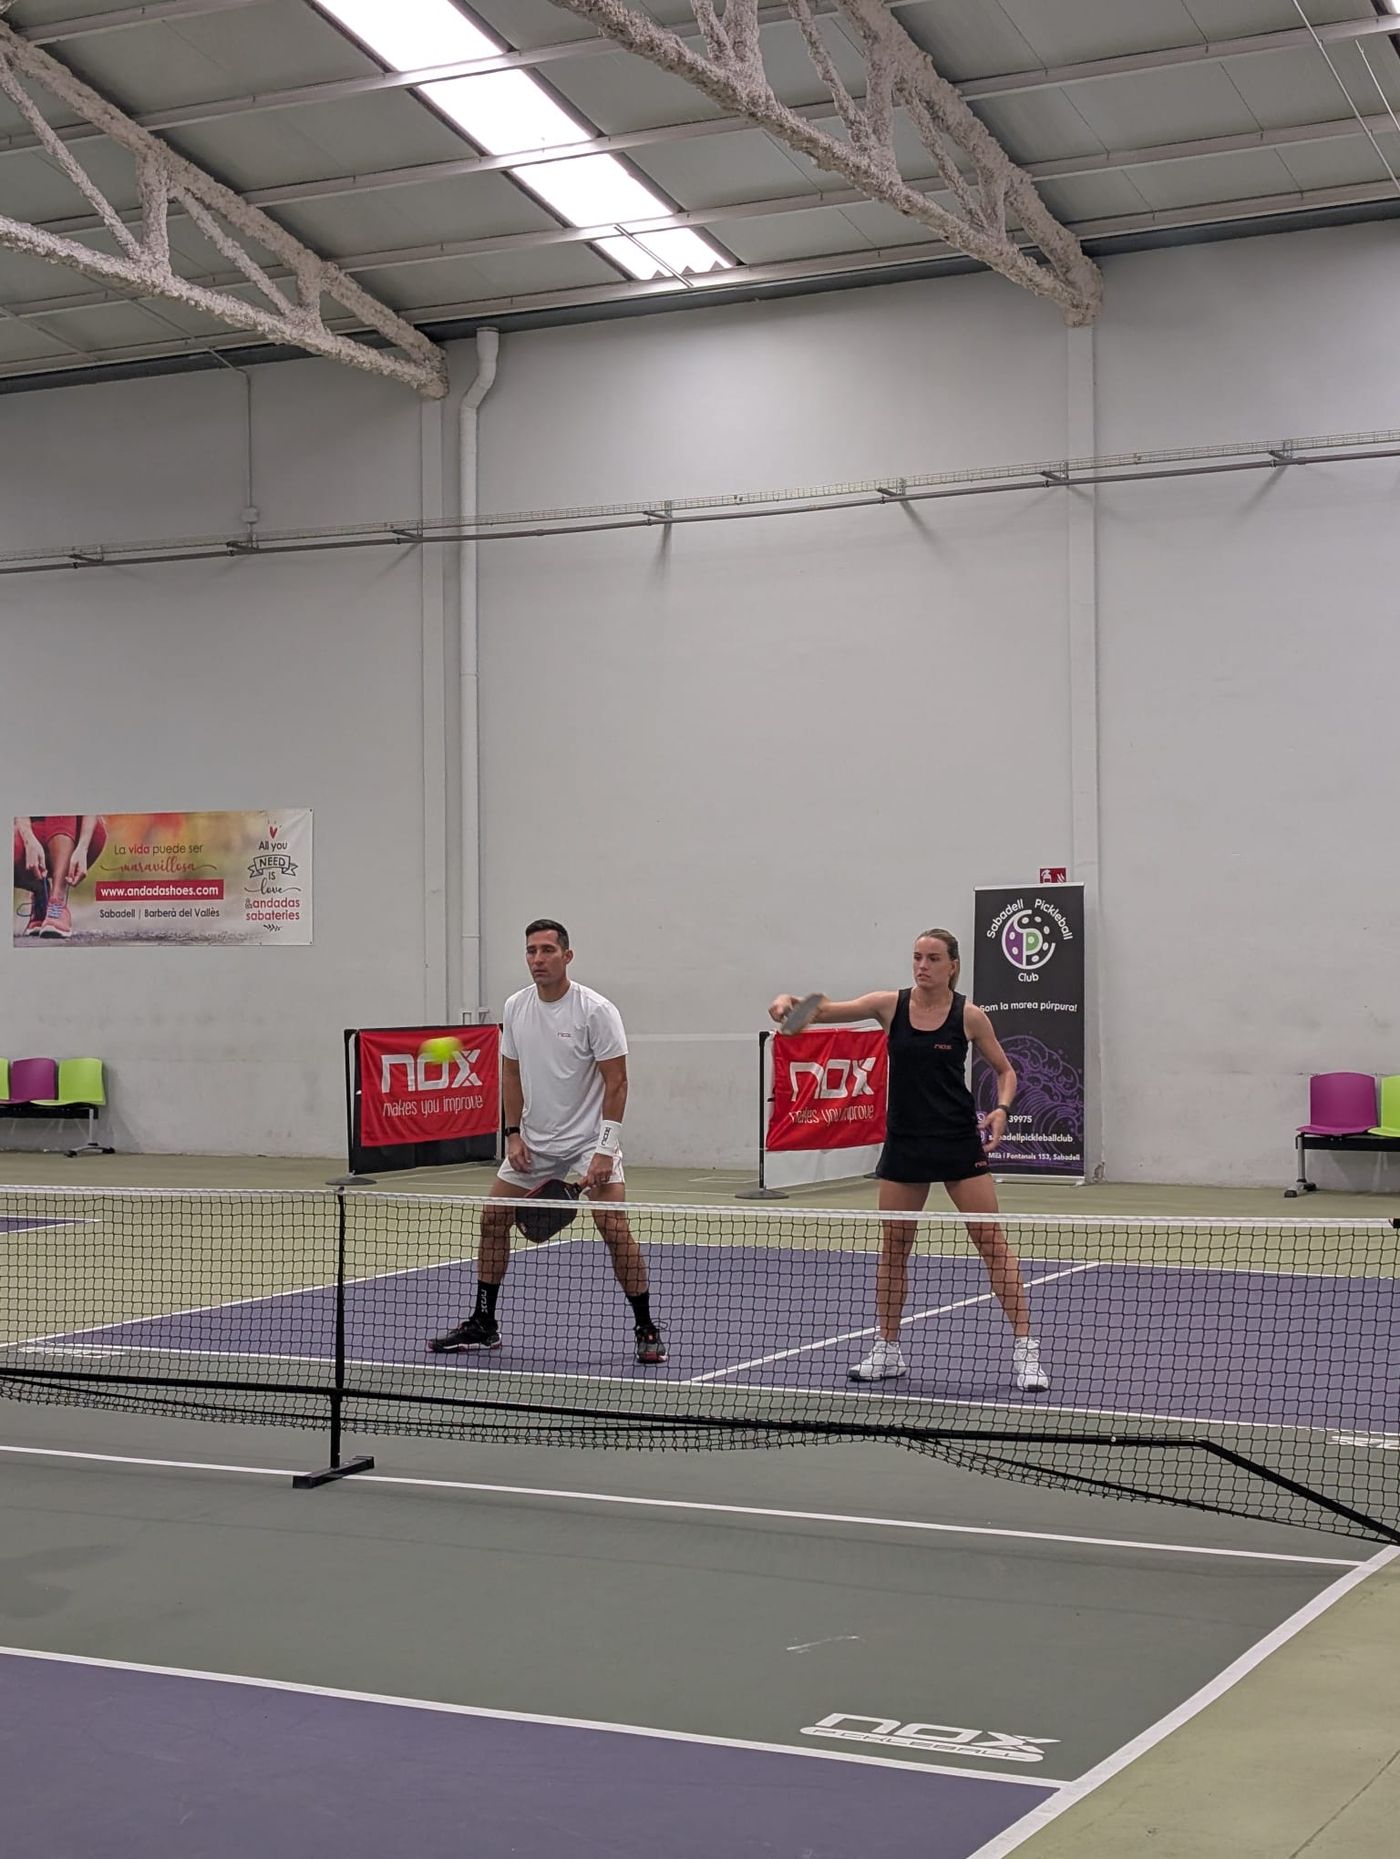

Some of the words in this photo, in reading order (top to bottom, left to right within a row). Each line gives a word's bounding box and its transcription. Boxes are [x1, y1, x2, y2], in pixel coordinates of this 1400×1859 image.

[114, 845, 126, 855] La
[129, 845, 150, 855] vida
[153, 844, 185, 856] puede
[189, 844, 203, 854] ser
[258, 841, 269, 850] All
[271, 842, 288, 852] you
[110, 856, 207, 873] maravillosa
[259, 857, 286, 867] NEED
[100, 885, 219, 897] www.andadashoes.com
[99, 909, 136, 918] Sabadell
[144, 907, 177, 918] Barberà
[178, 908, 192, 917] del
[194, 907, 220, 917] Vallès
[246, 909, 300, 921] sabateries
[987, 898, 1024, 939] Sabadell
[1034, 898, 1073, 940] Pickleball
[1018, 972, 1039, 982] Club
[1000, 1002, 1008, 1010] la
[1011, 1001, 1038, 1009] marea
[1040, 1001, 1078, 1013] púrpura!
[382, 1099, 418, 1117] makes
[421, 1097, 440, 1118] you
[443, 1095, 484, 1114] improve
[988, 1132, 1074, 1144] sadellpickleballclub
[1006, 1152, 1036, 1160] Fontanals
[1053, 1153, 1080, 1161] Sabadell
